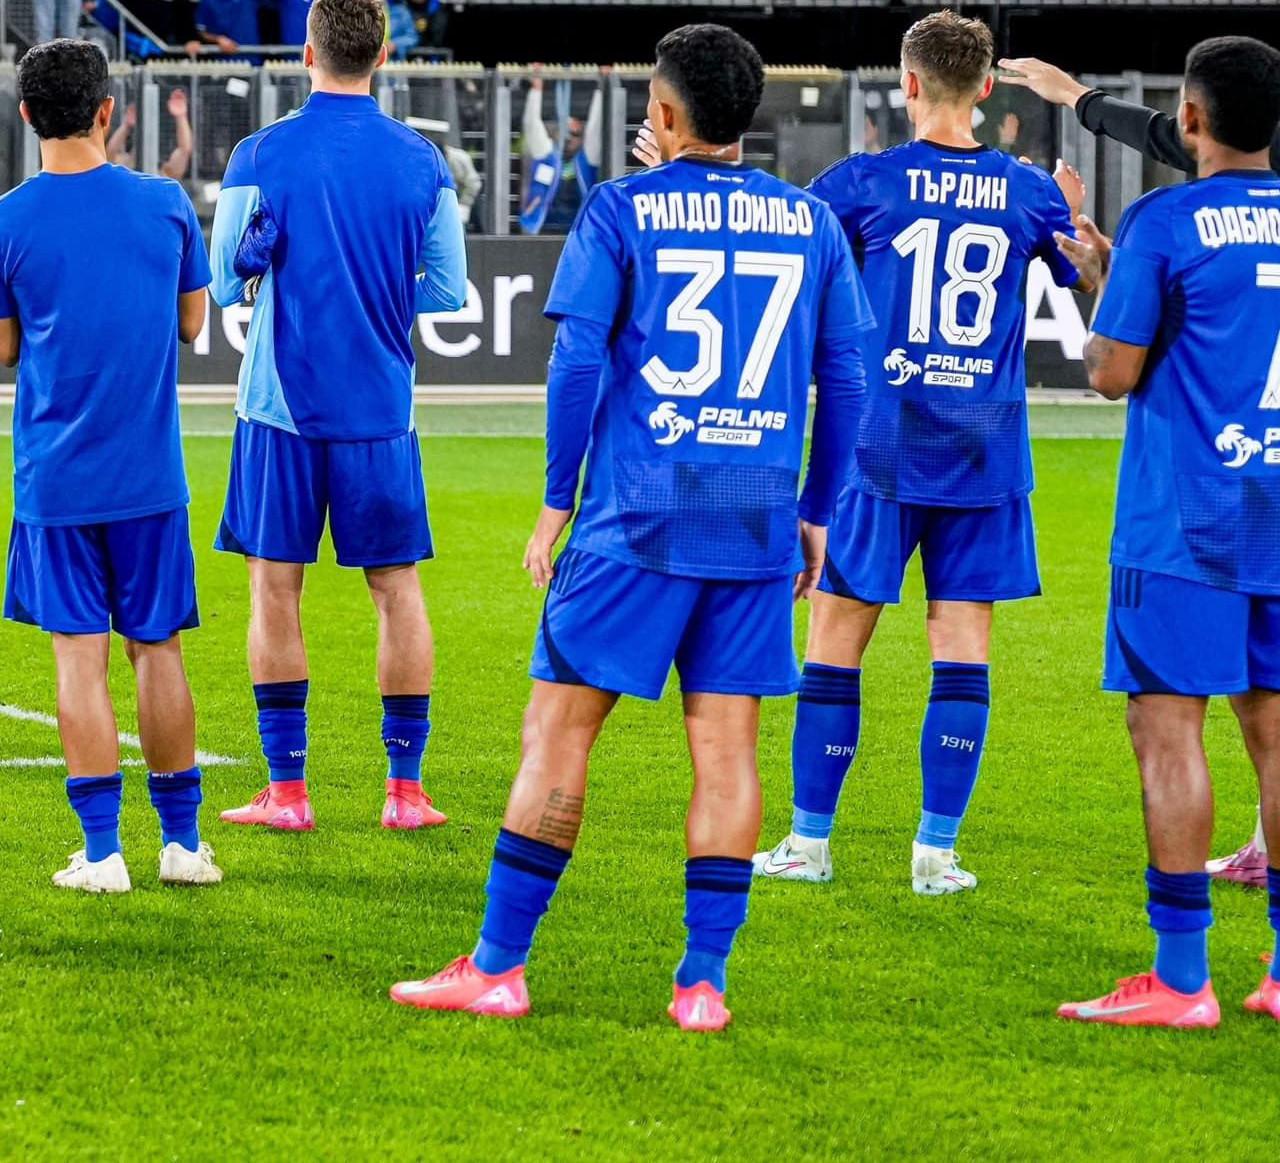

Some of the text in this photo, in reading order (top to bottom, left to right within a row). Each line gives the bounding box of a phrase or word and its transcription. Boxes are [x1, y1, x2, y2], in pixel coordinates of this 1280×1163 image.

[906, 168, 1008, 210] ТЪРДИН
[632, 189, 814, 236] РИЛДО ФИЛЬО
[891, 217, 1010, 347] 18
[640, 249, 804, 399] 37
[924, 353, 993, 374] PALMS
[931, 373, 969, 385] SPORT
[697, 406, 787, 430] PALMS
[706, 430, 752, 441] SPORT
[824, 744, 855, 757] 1914
[940, 734, 975, 752] 1914
